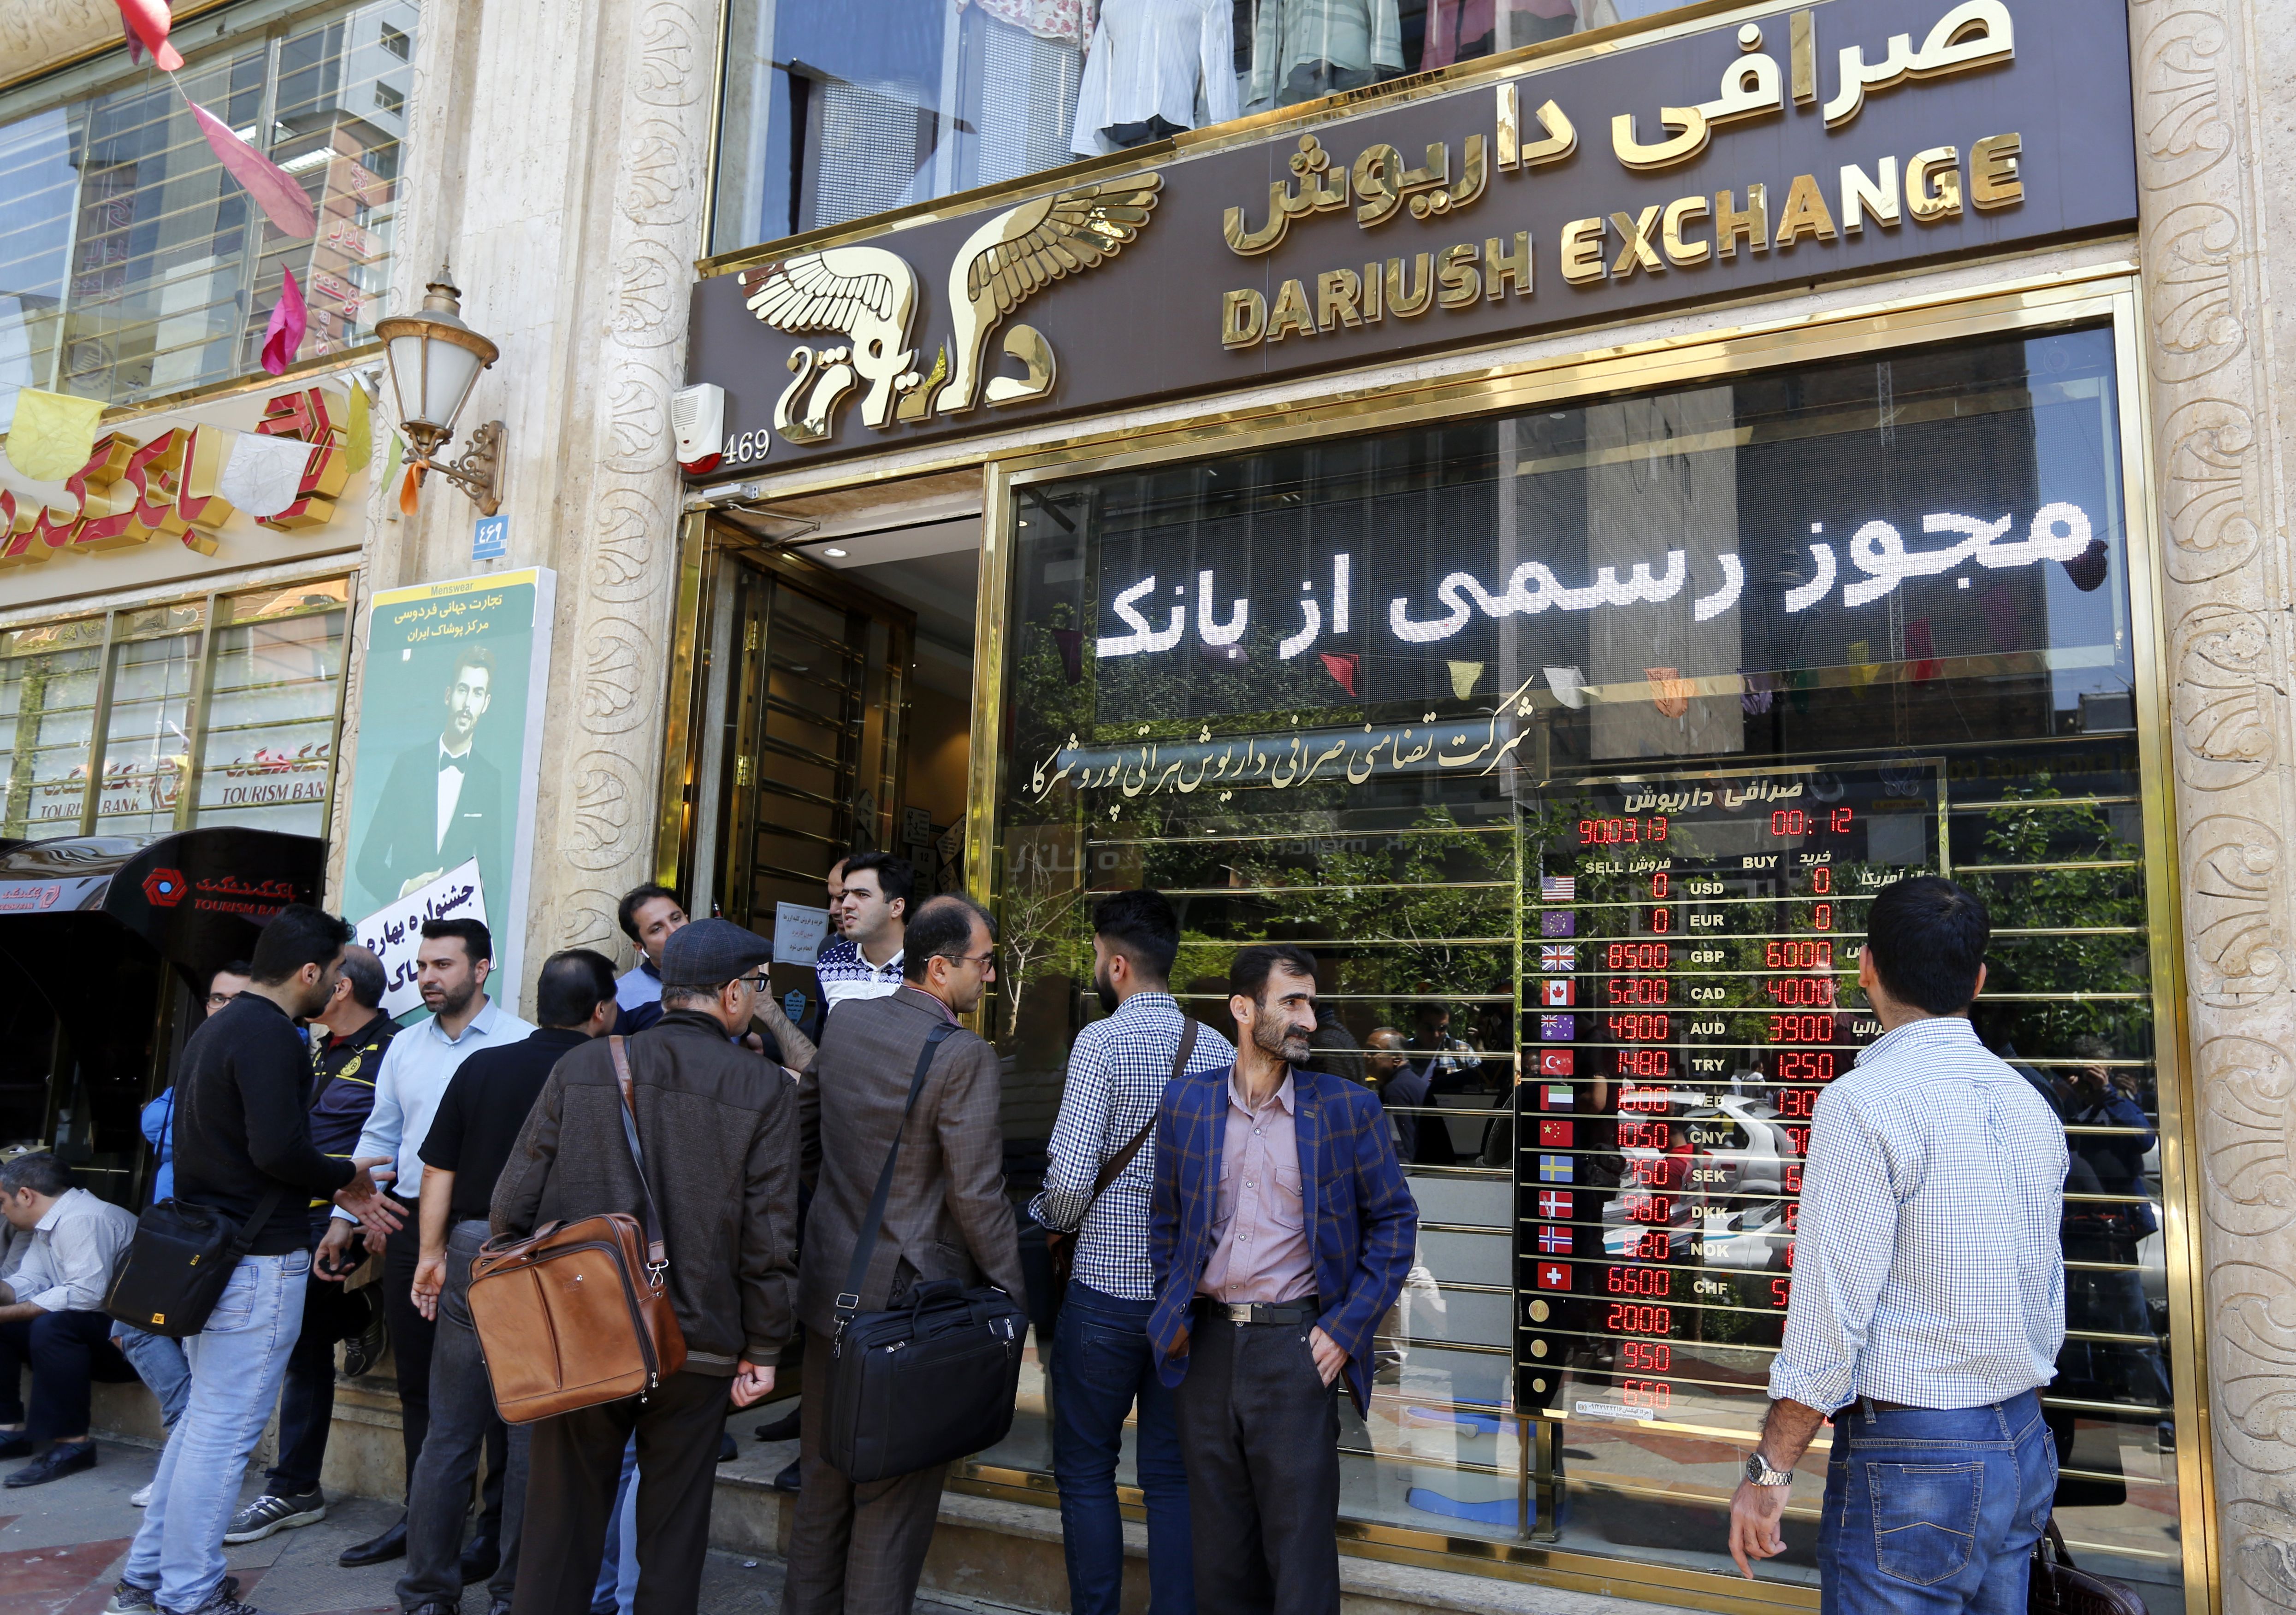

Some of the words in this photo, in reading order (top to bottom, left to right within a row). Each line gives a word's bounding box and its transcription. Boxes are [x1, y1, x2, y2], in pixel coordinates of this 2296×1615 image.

[1613, 0, 2015, 170] صرافی
[1222, 82, 1577, 256] داریوش
[1222, 230, 1533, 349] DARIUSH
[1560, 132, 2024, 286] EXCHANGE
[722, 428, 772, 466] 469
[1785, 501, 2092, 614] مجوز
[431, 583, 473, 596] Menswear
[469, 594, 503, 611] تجارت
[1390, 550, 1744, 643] رسمی
[394, 603, 438, 625] فردوسی
[439, 601, 467, 618] جهانی
[1096, 571, 1248, 660] بانک
[1280, 553, 1350, 660] از
[407, 626, 430, 642] ایران
[431, 623, 464, 638] پوشاک
[465, 619, 489, 635] مرکز
[1438, 674, 1534, 777] شرکت
[1271, 714, 1347, 789] صرافی
[1346, 711, 1437, 784] تضامنی
[1178, 724, 1267, 802] داریوش
[223, 783, 289, 804] TOURISM
[292, 781, 326, 799] BAN
[1624, 785, 1714, 813] داریوش
[1725, 780, 1803, 807] صرافی
[41, 802, 83, 818] TOURI
[920, 852, 929, 862] 12
[1585, 861, 1624, 874] SELL
[1628, 856, 1671, 873] فروش
[1742, 855, 1779, 869] BUY
[1799, 850, 1832, 865] خرید
[1653, 873, 1667, 898] 0
[1690, 882, 1724, 896] USD
[1814, 867, 1830, 893] 0
[195, 899, 255, 914] TOURISM
[258, 904, 284, 915] BAN
[1653, 908, 1668, 933] 0
[1690, 913, 1724, 928] EUR
[1815, 904, 1830, 930] 0
[367, 920, 405, 957] بهاره
[1609, 943, 1668, 968] 8500
[1691, 949, 1725, 964] GBP
[1767, 941, 1831, 967] 6000
[1609, 979, 1668, 1004] 5200
[1691, 987, 1726, 1002] CAD
[1768, 978, 1833, 1005] 4000
[1609, 1015, 1668, 1040] 4900
[1691, 1021, 1726, 1036] AUD
[1769, 1015, 1833, 1041] 3900
[1618, 1051, 1668, 1076] 1480
[1692, 1058, 1725, 1073] TRY
[1779, 1053, 1833, 1079] 1250
[1691, 1094, 1725, 1108] AED
[1618, 1122, 1668, 1149] 1050
[1690, 1131, 1727, 1145] CNY
[1692, 1168, 1727, 1183] SEK
[1623, 1195, 1669, 1222] 980
[1691, 1206, 1728, 1220] DKK
[1690, 1243, 1730, 1258] NOK
[1608, 1267, 1669, 1296] 6600
[1693, 1280, 1728, 1295] CHF
[1608, 1304, 1669, 1334] 2000
[1624, 1342, 1670, 1371] 950
[1623, 1380, 1670, 1409] 650
